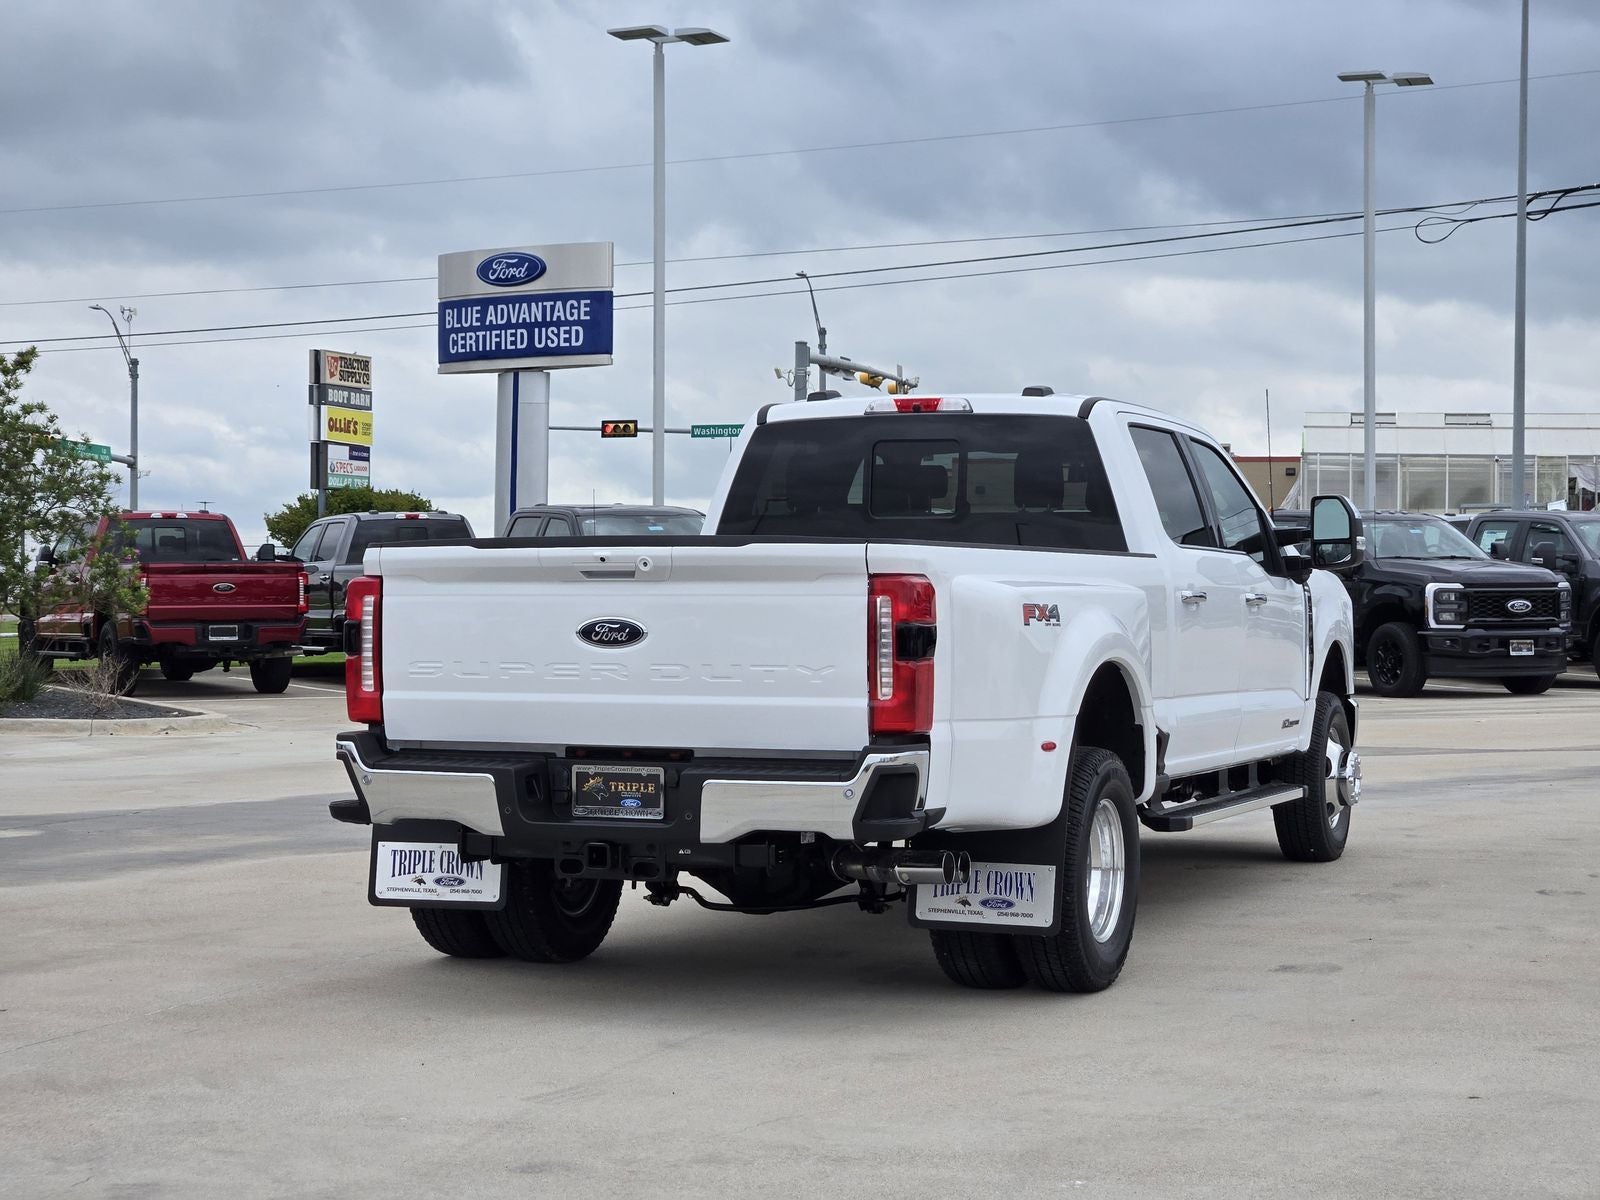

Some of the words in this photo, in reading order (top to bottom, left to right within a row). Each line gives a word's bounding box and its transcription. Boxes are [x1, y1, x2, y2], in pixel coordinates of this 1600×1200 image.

[489, 258, 529, 280] Ford
[445, 306, 481, 329] BLUE
[486, 299, 591, 326] ADVANTAGE
[449, 328, 528, 354] CERTIFIED
[534, 325, 584, 348] USED
[338, 356, 370, 372] TRACTOR
[338, 370, 362, 384] SUPPLY
[328, 388, 349, 403] BOOT
[350, 392, 371, 407] BARN
[328, 476, 353, 488] DOLLAR
[1023, 603, 1061, 626] FX4
[591, 623, 630, 641] Ford
[407, 660, 629, 681] SUPER
[650, 663, 836, 684] DUTY
[609, 781, 656, 794] TRIPLE
[390, 849, 436, 878] TRIPLE
[440, 850, 484, 880] CROWN
[440, 877, 459, 886] Ford
[986, 870, 1036, 903] CROWN
[986, 899, 1007, 908] Ford
